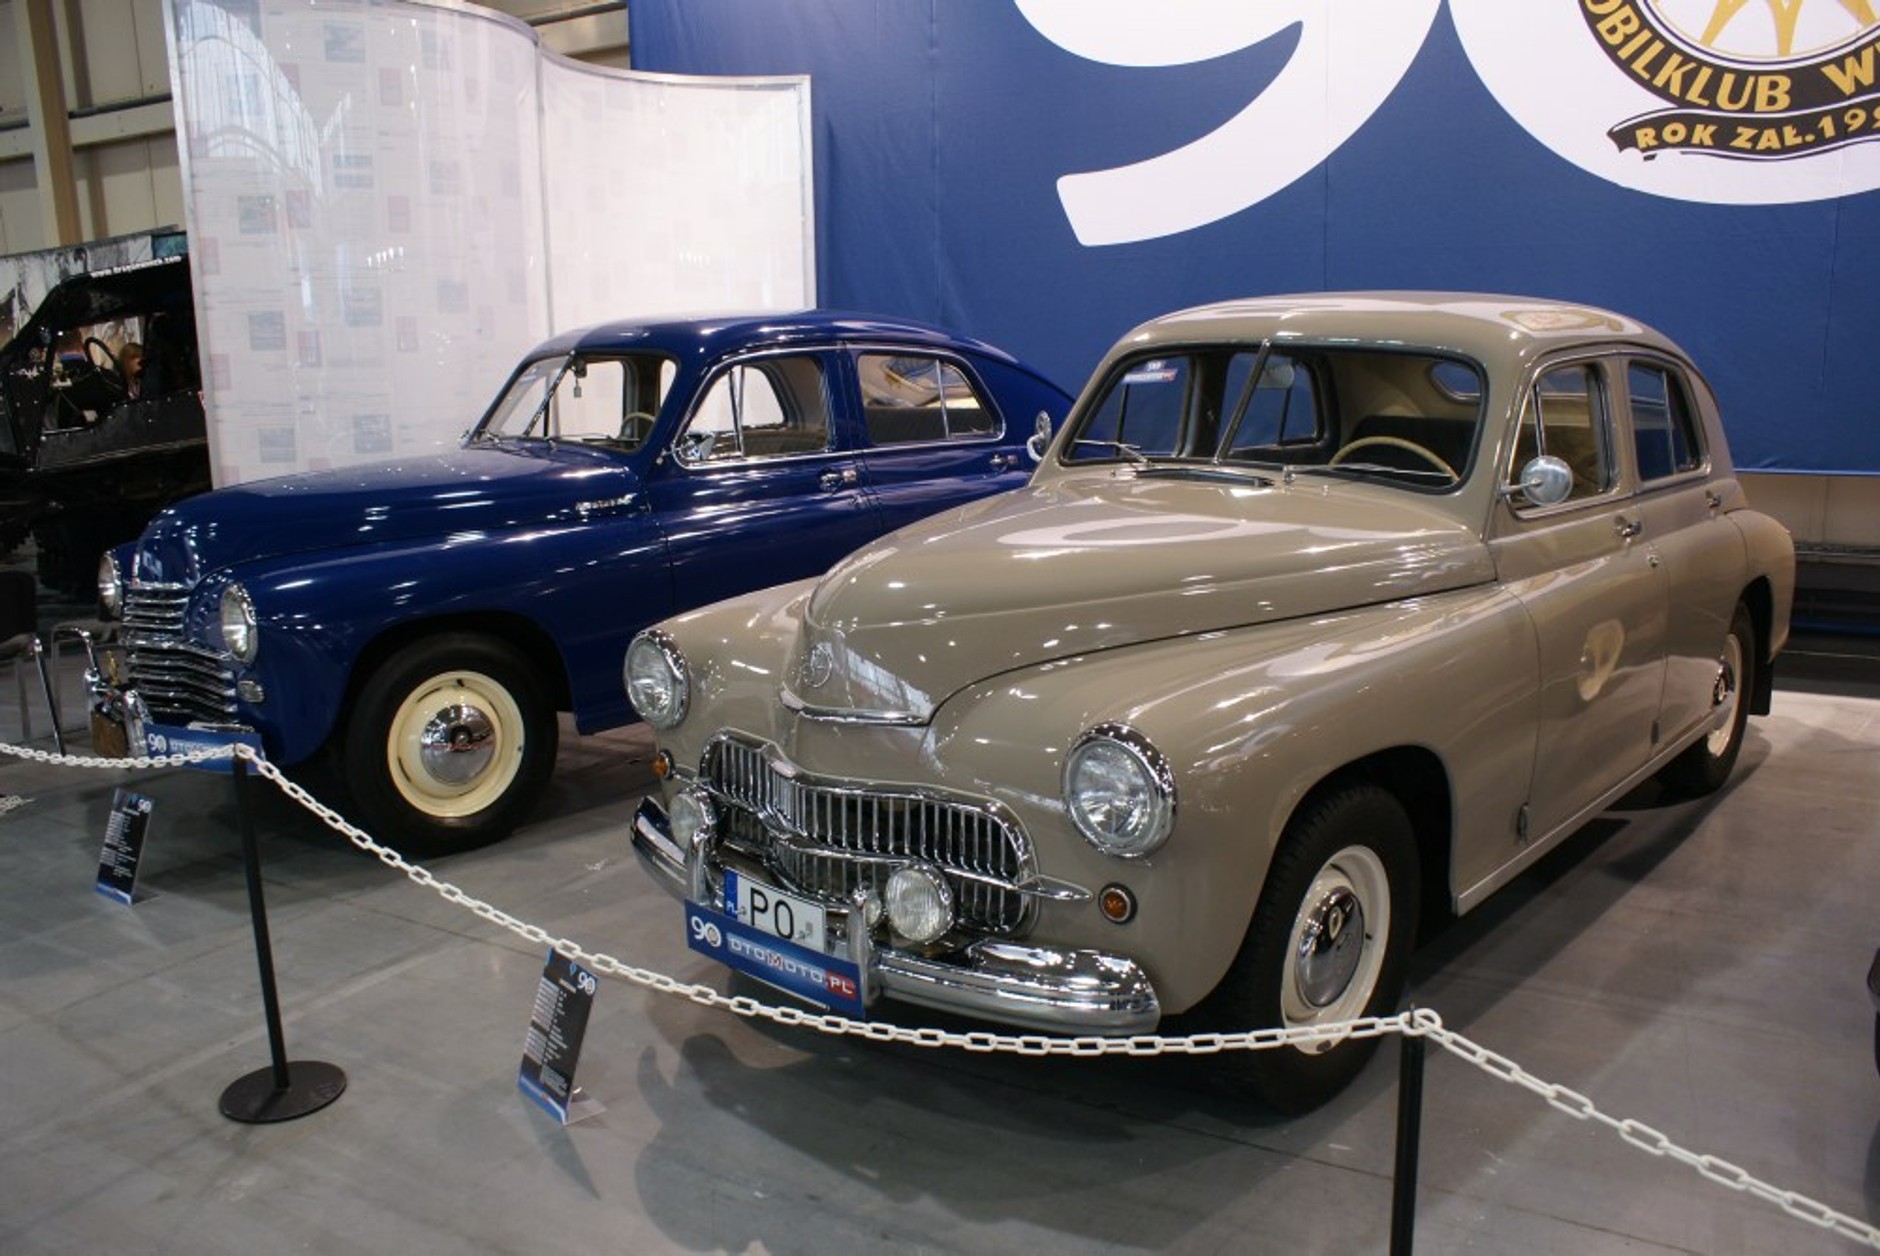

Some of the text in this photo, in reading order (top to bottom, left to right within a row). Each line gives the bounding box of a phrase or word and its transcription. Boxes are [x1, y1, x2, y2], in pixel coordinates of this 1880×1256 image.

[1820, 41, 1880, 96] W
[1635, 122, 1718, 149] ROK
[148, 733, 167, 753] 90
[726, 900, 740, 915] PL
[751, 887, 794, 940] PO
[691, 915, 721, 948] 90
[577, 971, 596, 996] 90
